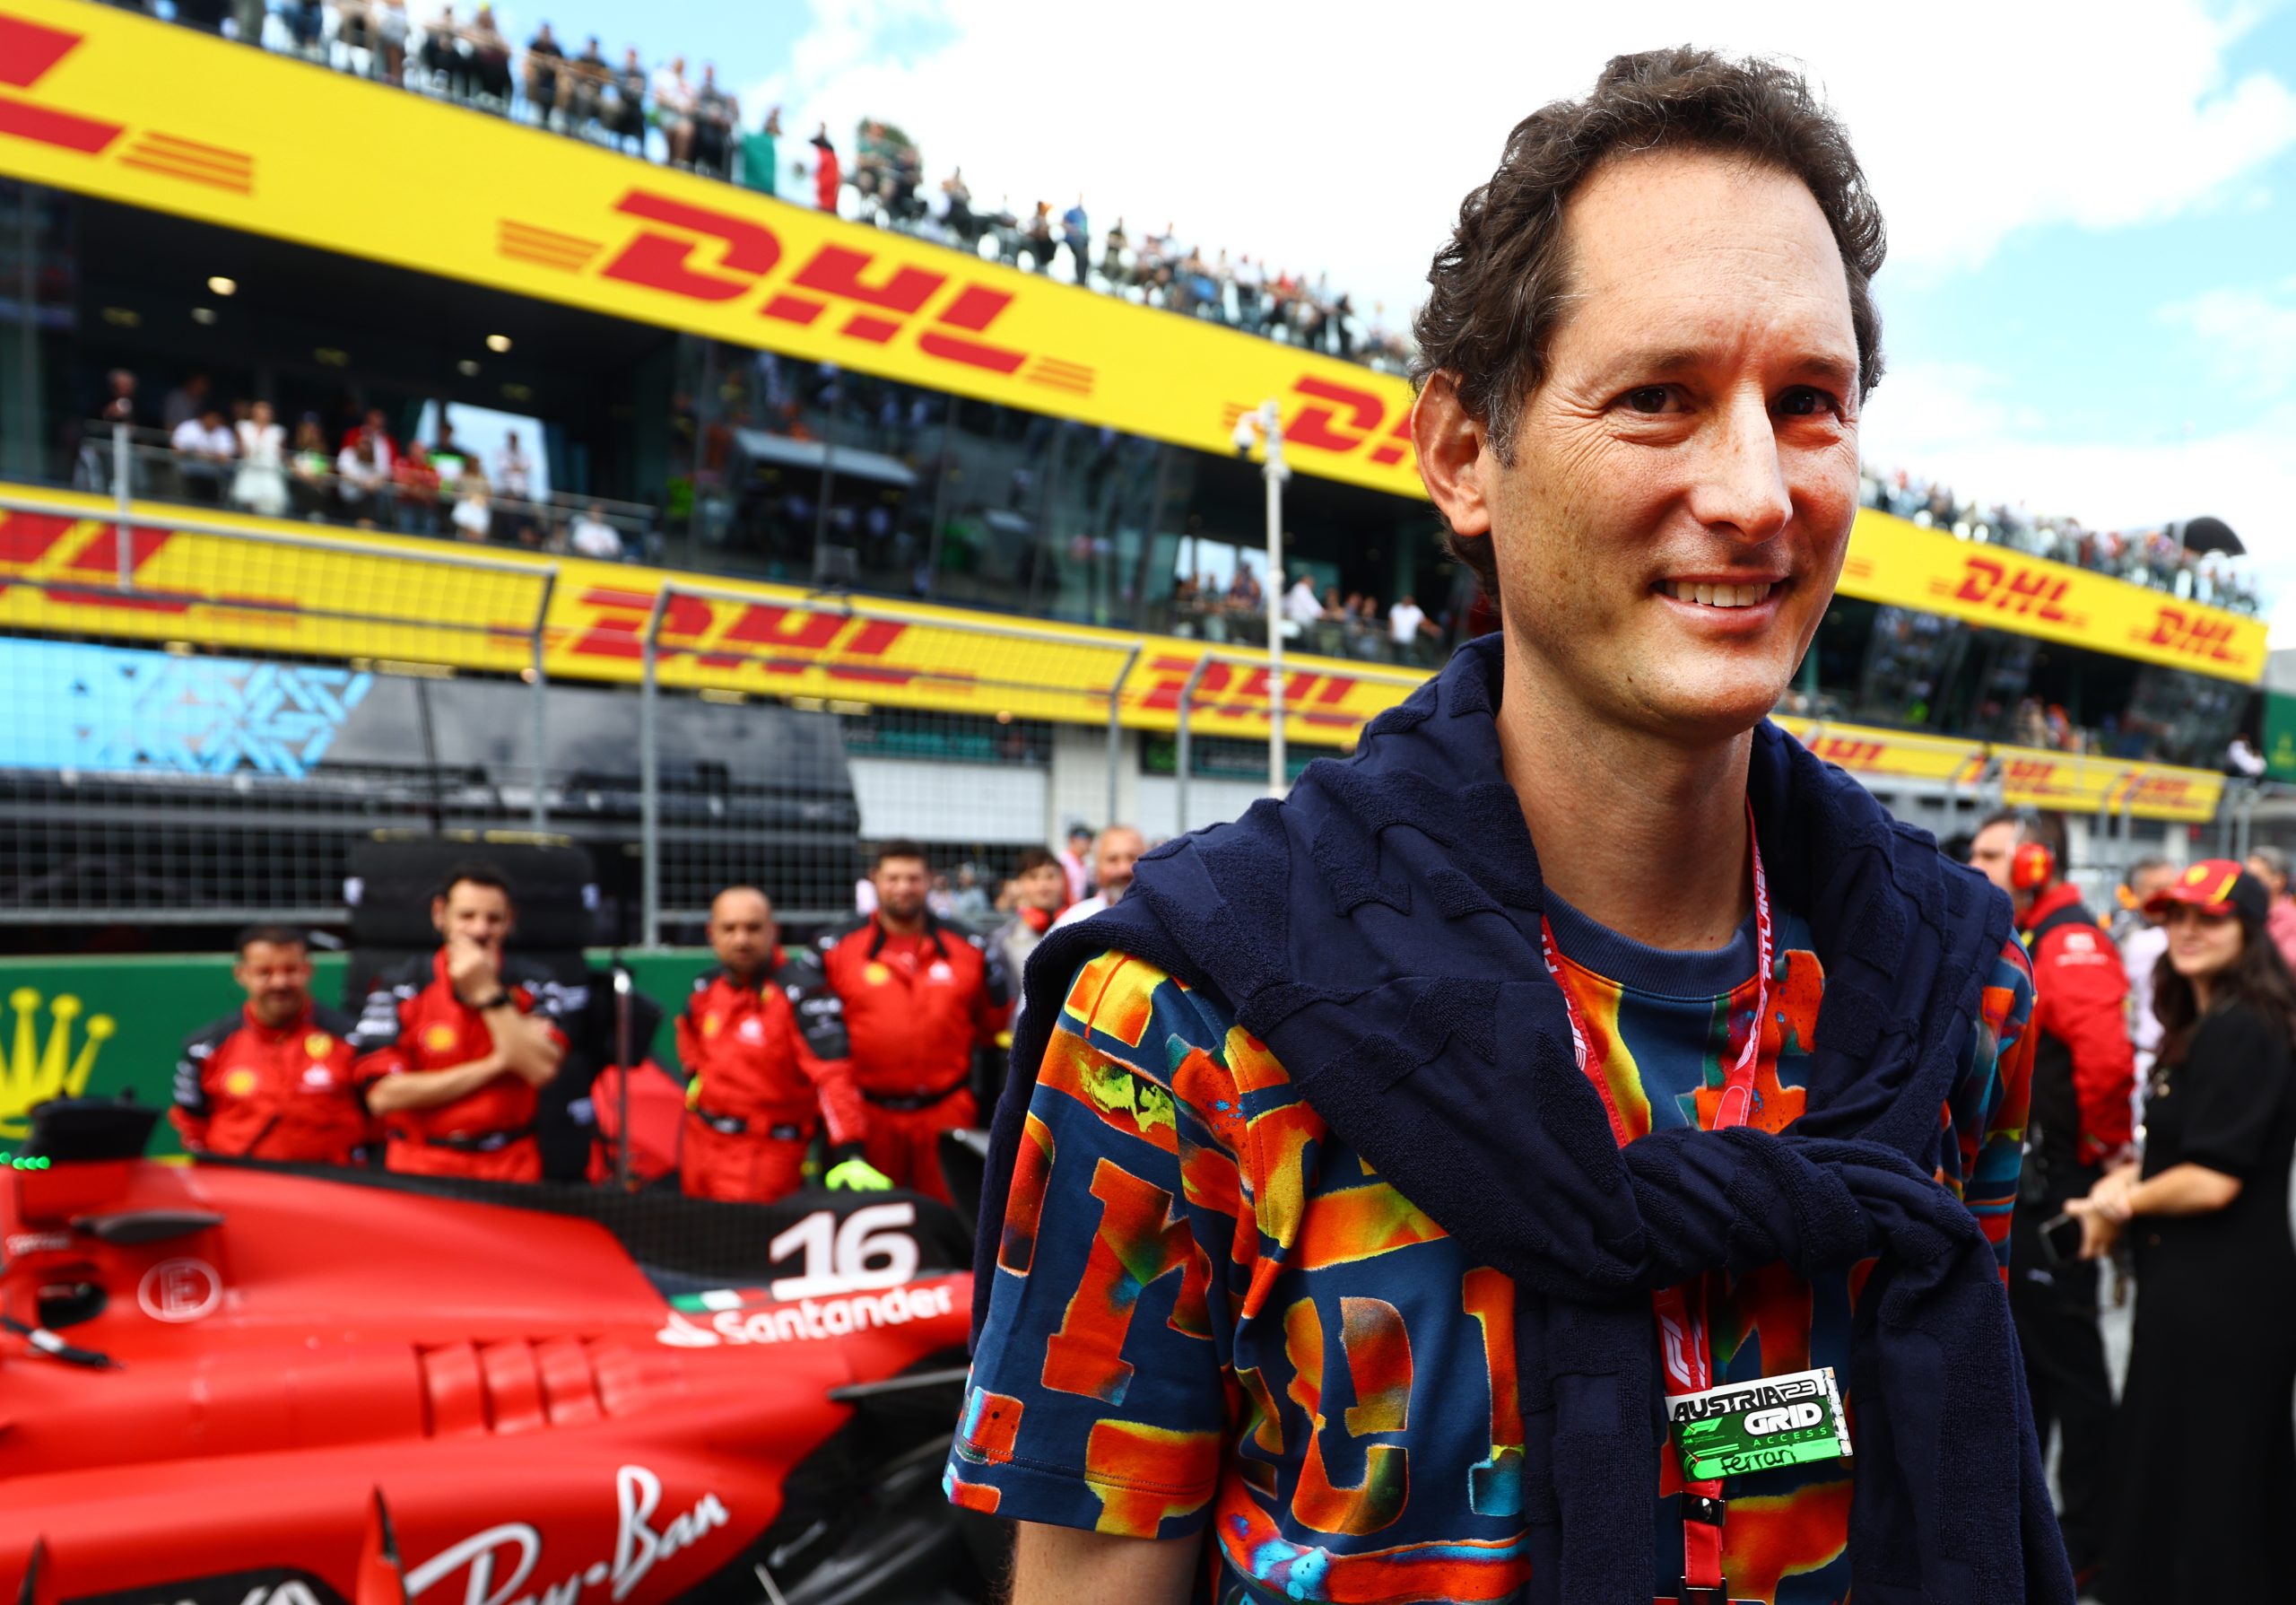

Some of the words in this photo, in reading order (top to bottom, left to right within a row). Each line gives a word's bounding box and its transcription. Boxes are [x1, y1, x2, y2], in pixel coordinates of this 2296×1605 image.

[600, 188, 1028, 376] DHL
[1956, 555, 2071, 620] DHL
[572, 589, 927, 685] DHL
[2149, 606, 2234, 660] DHL
[1757, 870, 1772, 981] PITLANE
[770, 1202, 919, 1301] 16
[713, 1284, 953, 1345] Santander
[1744, 1403, 1822, 1435] GRID
[1753, 1427, 1828, 1446] ACCESS
